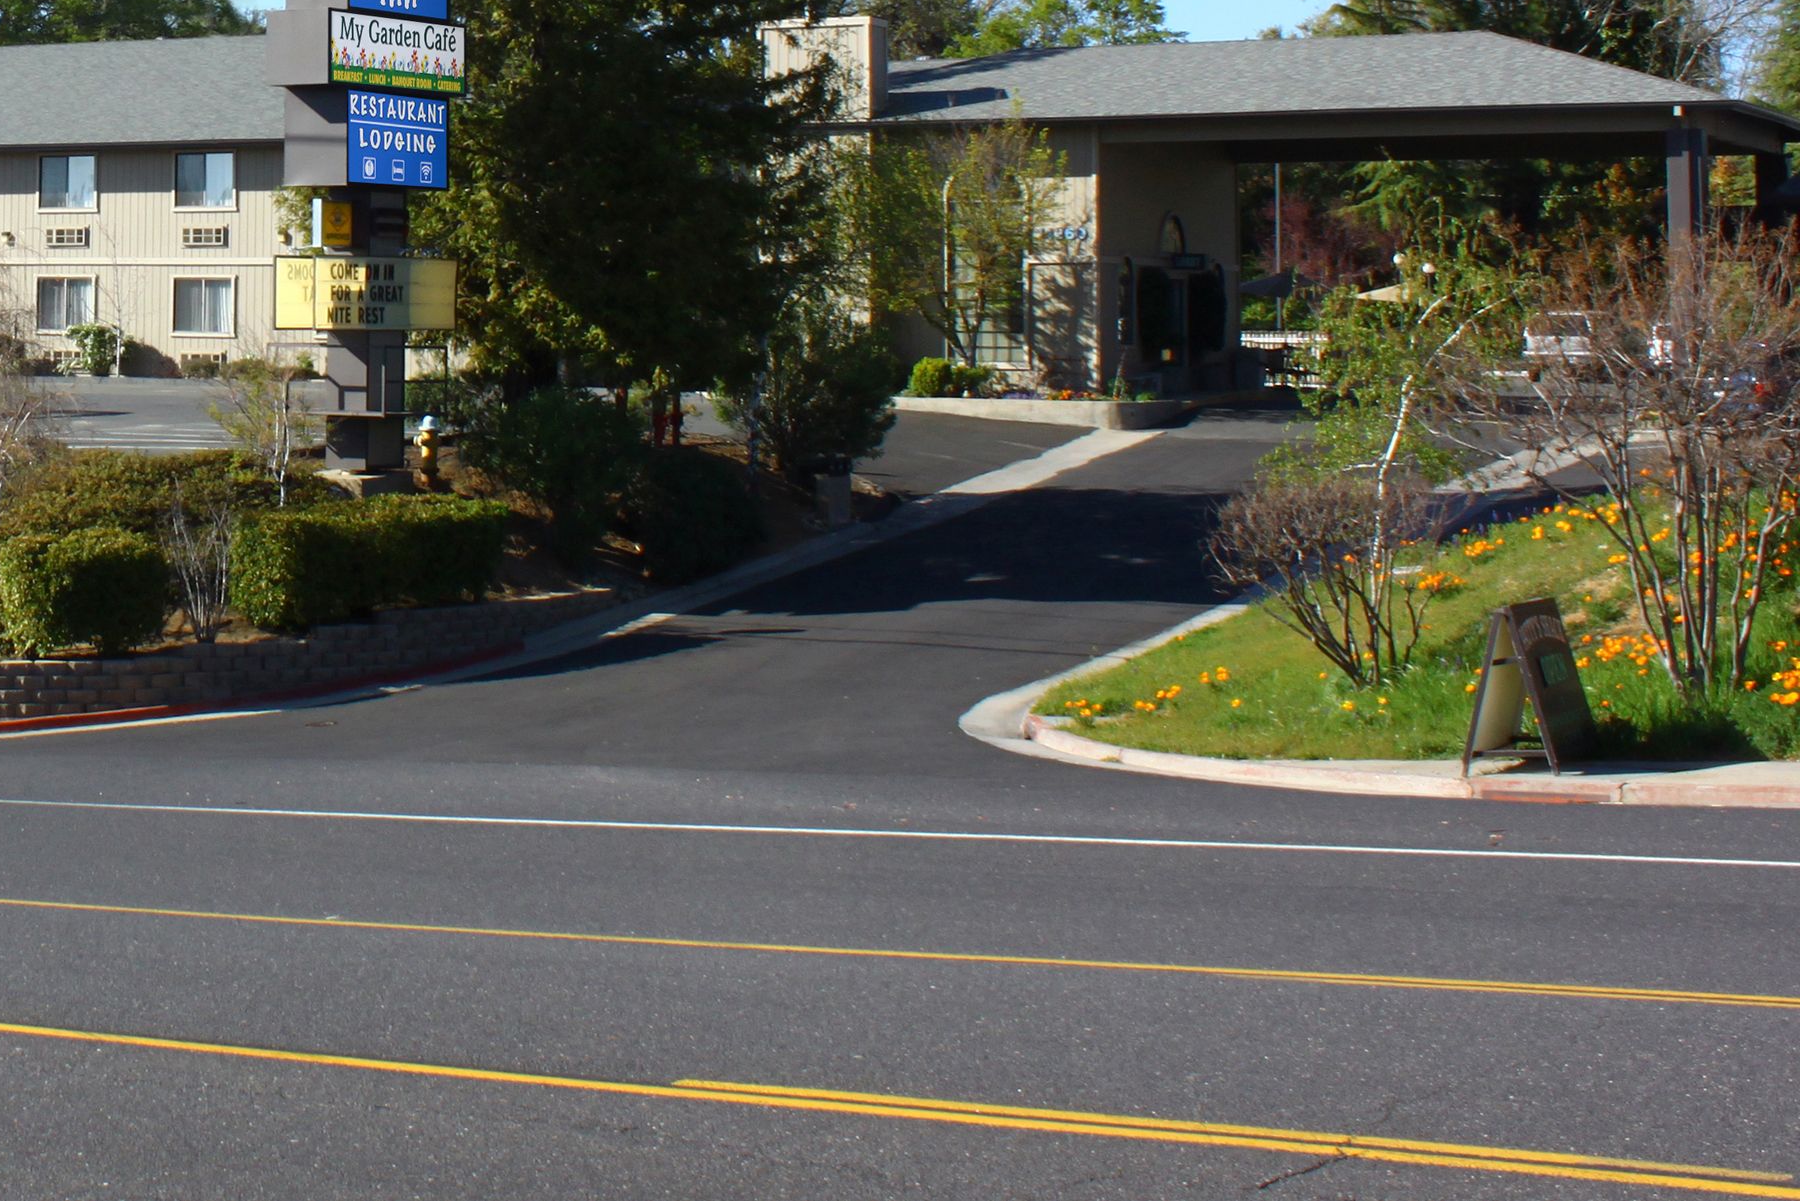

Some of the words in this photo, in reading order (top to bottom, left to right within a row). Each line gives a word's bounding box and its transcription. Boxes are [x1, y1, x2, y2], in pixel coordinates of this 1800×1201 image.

[340, 16, 364, 47] My
[369, 19, 421, 48] Garden
[424, 25, 457, 52] Café
[333, 70, 363, 83] BREAKFAST
[369, 73, 386, 85] LUNCH
[392, 76, 416, 88] BANQUET
[416, 78, 432, 89] ROOM
[437, 80, 461, 92] CATERING
[350, 94, 445, 125] RESTAURANT
[359, 128, 437, 154] LODGING
[330, 263, 359, 281] COME
[365, 263, 380, 281] ON
[383, 264, 395, 281] IN
[330, 285, 351, 302] FOR
[357, 286, 364, 302] A
[369, 285, 404, 303] GREAT
[327, 306, 351, 324] NITE
[358, 306, 385, 324] REST
